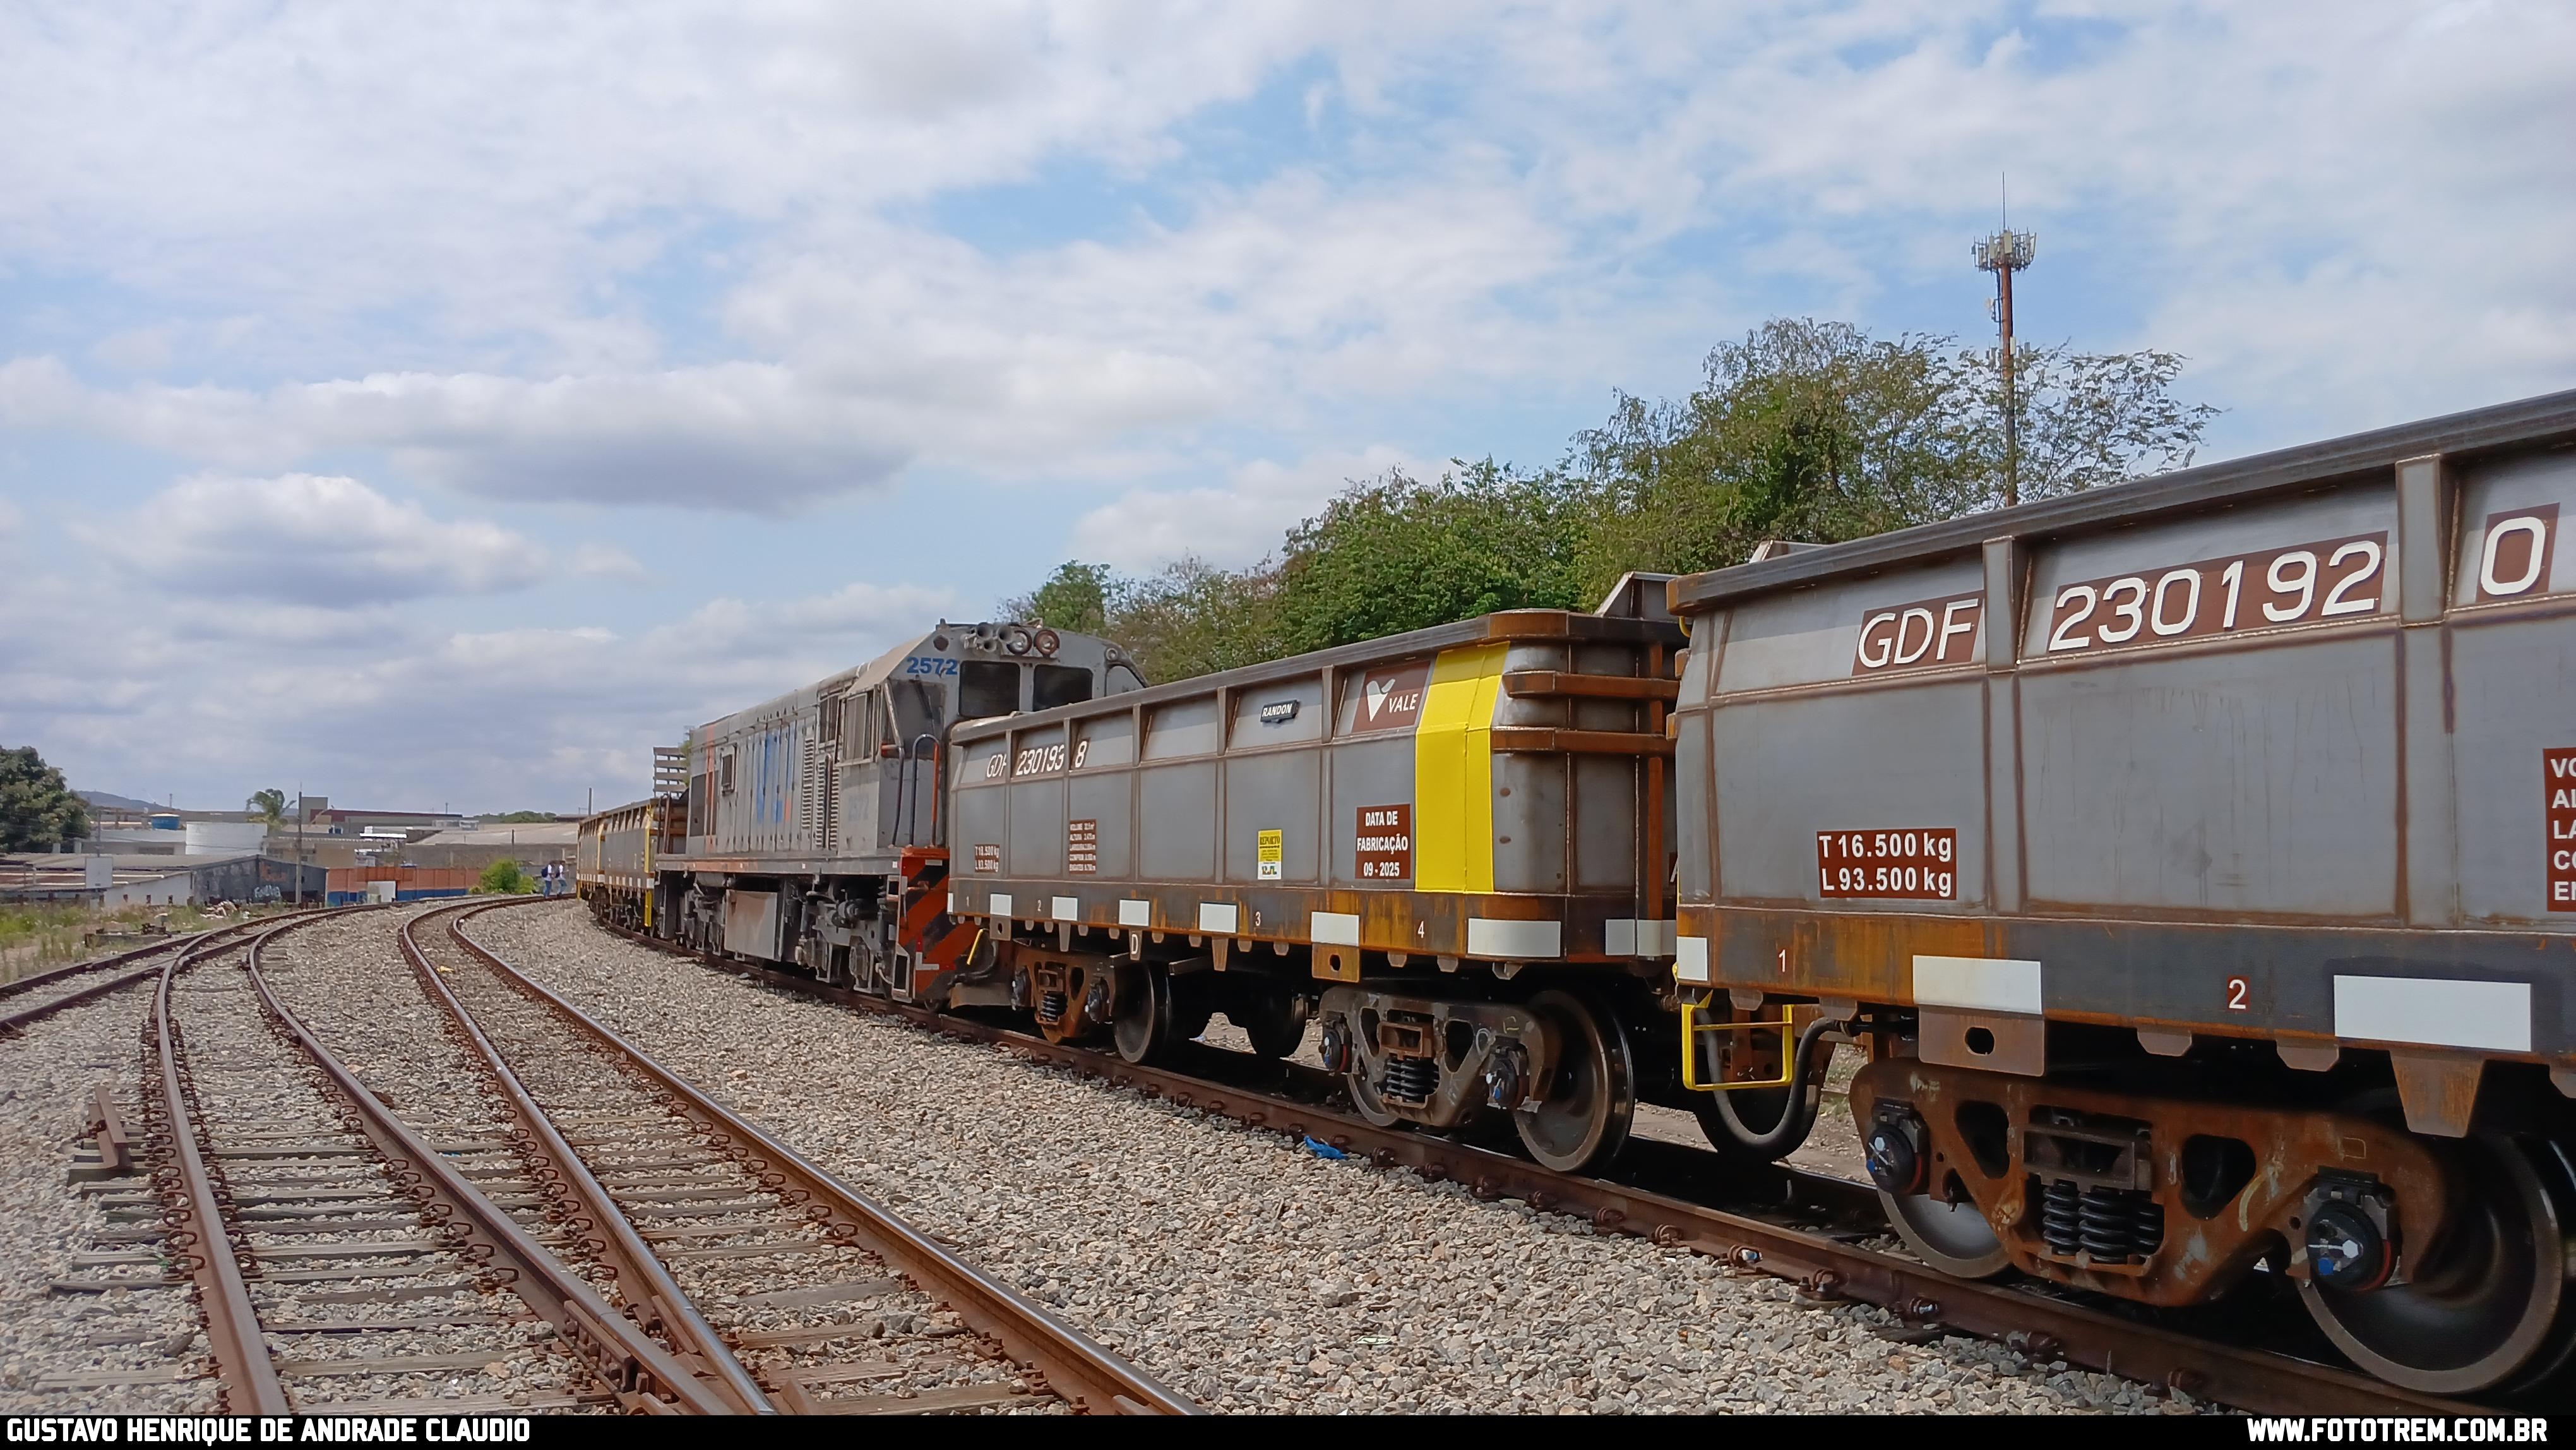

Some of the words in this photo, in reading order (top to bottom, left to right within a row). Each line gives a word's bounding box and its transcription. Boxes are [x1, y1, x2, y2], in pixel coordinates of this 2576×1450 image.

[1859, 598, 1978, 668] GDF
[2048, 541, 2382, 651] 230192
[2480, 517, 2546, 595] 0
[907, 657, 958, 675] 2572
[1262, 704, 1292, 717] RANDON
[1389, 693, 1419, 713] VALE
[1016, 744, 1064, 776] 230193
[1075, 741, 1087, 768] 8
[1365, 812, 1385, 826] DATA
[1386, 811, 1398, 825] DE
[1357, 833, 1408, 854] FABRICAÇÃO
[1818, 836, 1832, 858] T
[1838, 833, 1916, 858] 16.500
[1923, 832, 1951, 862] kg
[1364, 862, 1373, 877] 09
[1380, 862, 1400, 877] 2025
[1822, 868, 1835, 890] L
[1839, 867, 1917, 891] 93.500
[1924, 866, 1951, 897] kg
[966, 896, 970, 908] 1
[1037, 899, 1042, 912] 2
[1255, 911, 1261, 926] 3
[1417, 921, 1424, 938] 4
[1131, 933, 1138, 954] D
[1779, 949, 1786, 973] 1
[2229, 979, 2246, 1009] 2
